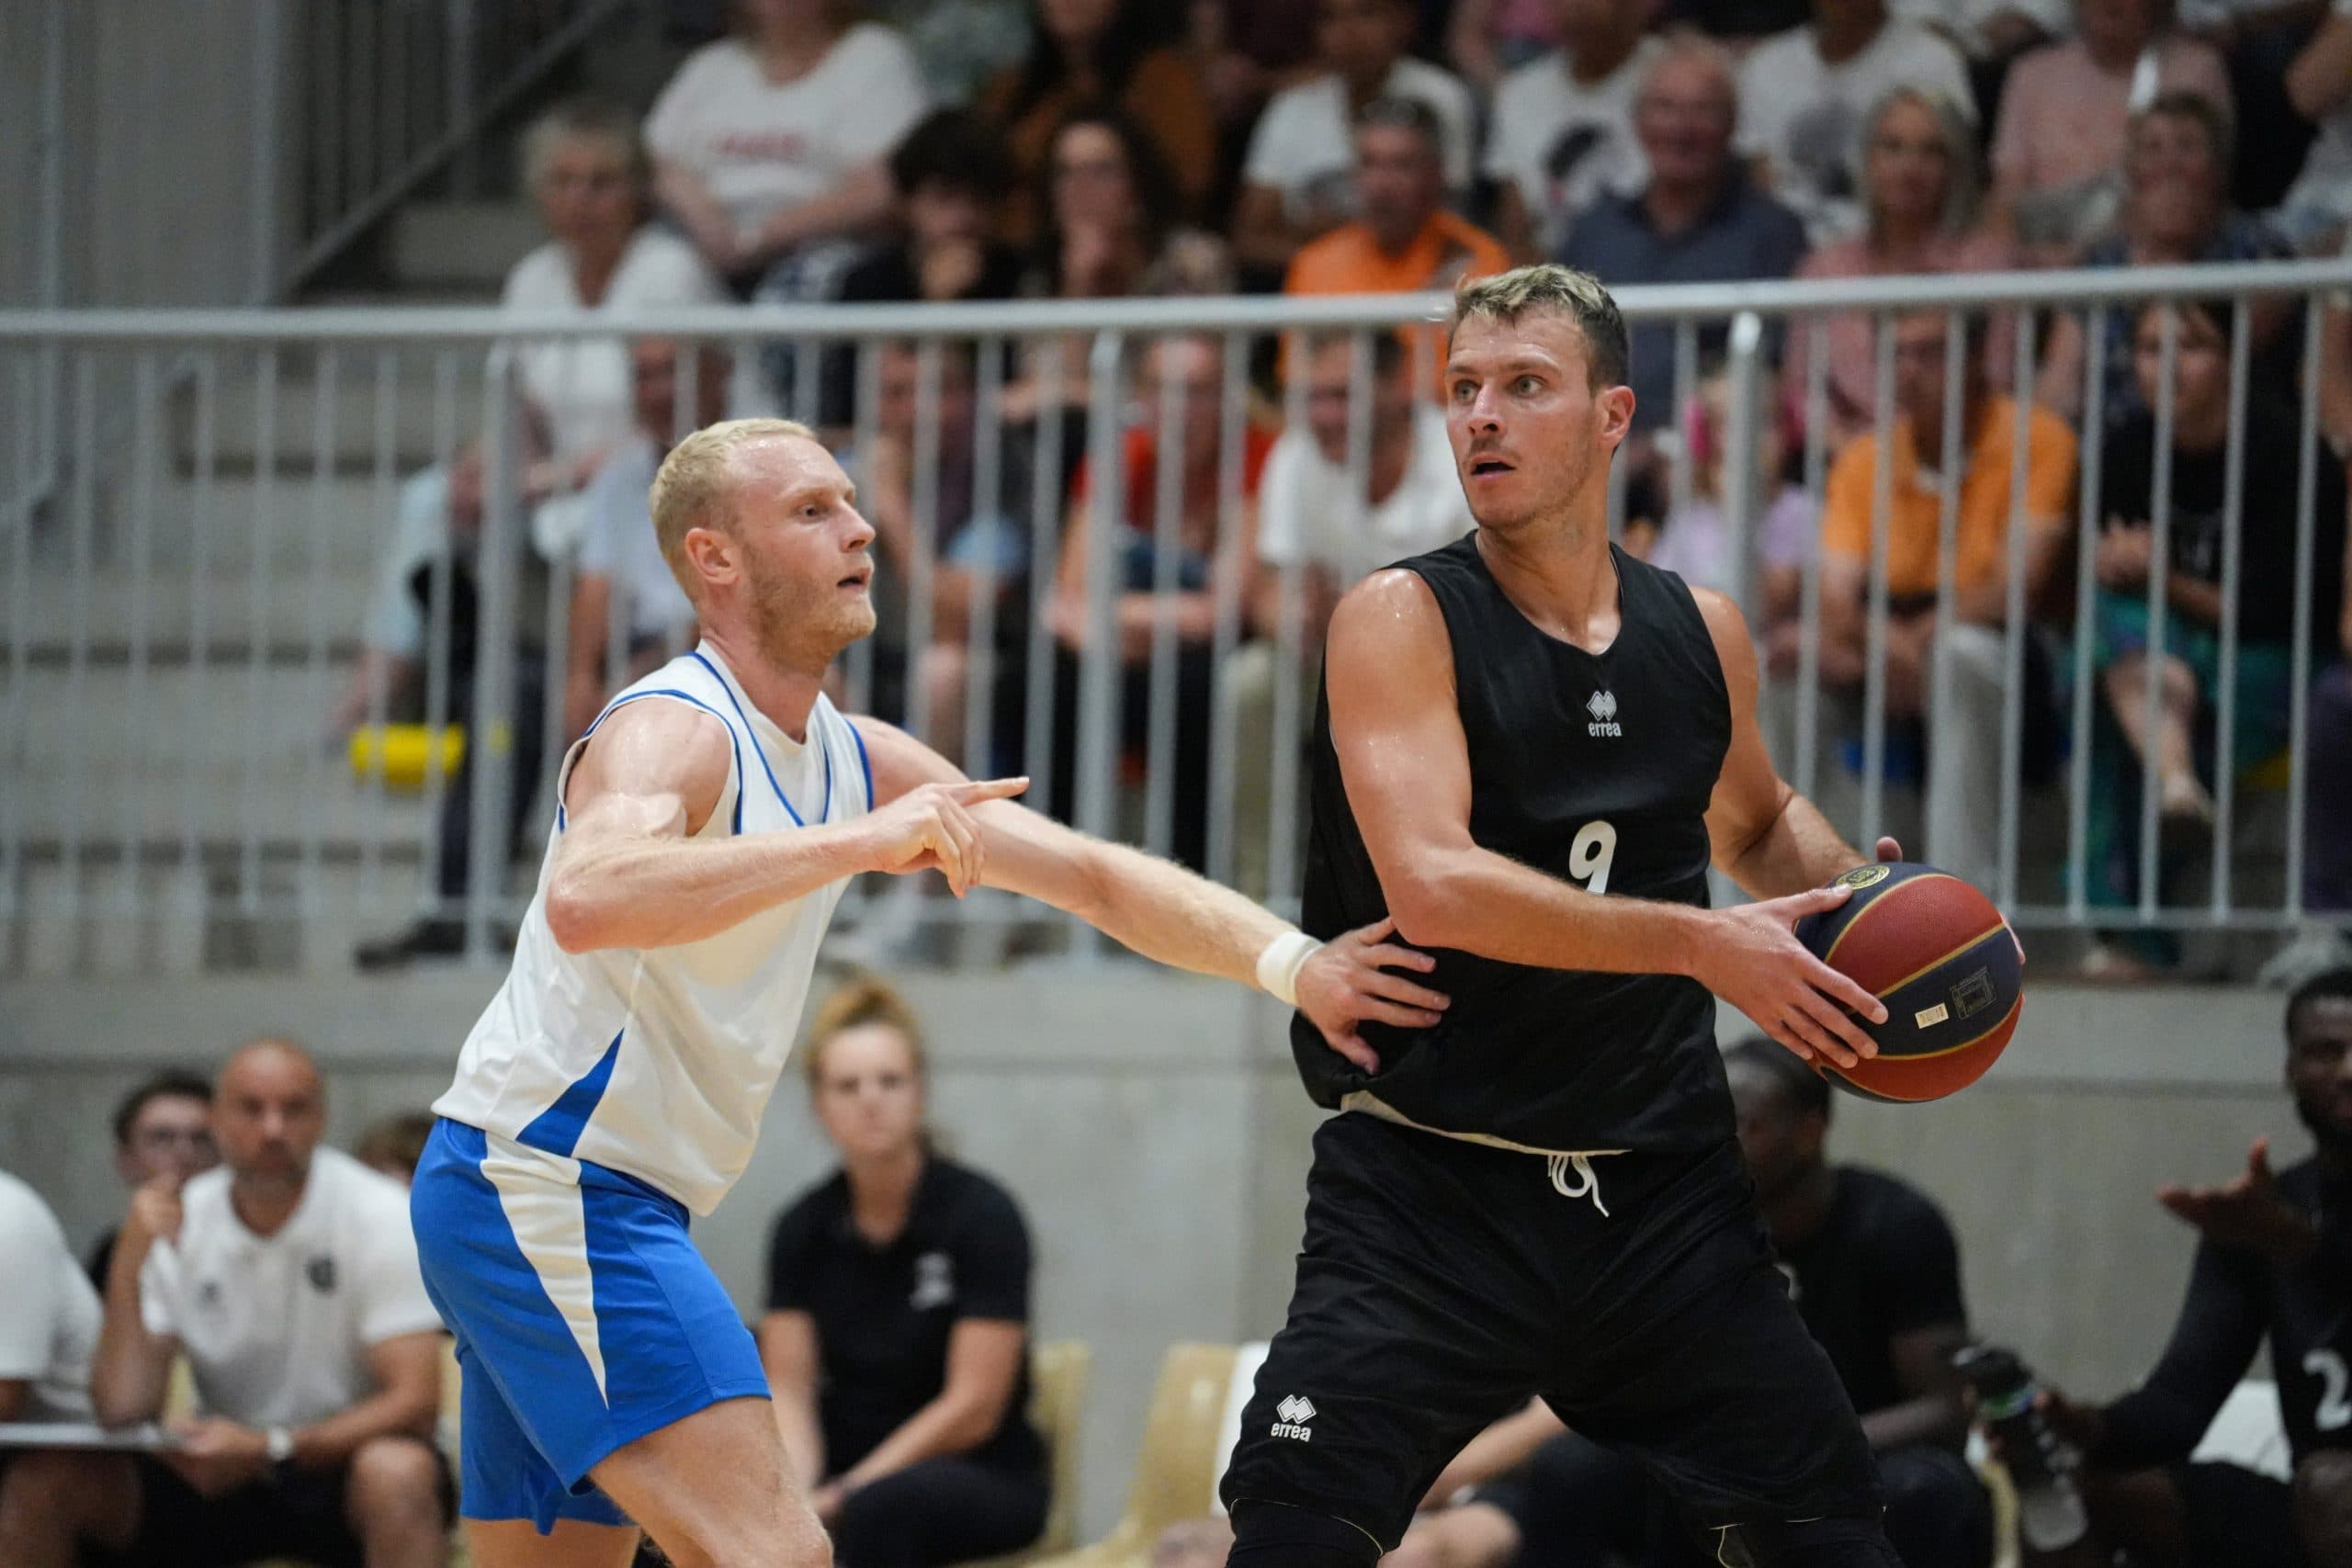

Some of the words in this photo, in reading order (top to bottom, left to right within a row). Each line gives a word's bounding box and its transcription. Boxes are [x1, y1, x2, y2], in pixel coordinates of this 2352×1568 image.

[1588, 722, 1623, 737] errea
[1568, 820, 1617, 895] 9
[2302, 1349, 2352, 1430] 2
[1270, 1422, 1312, 1443] errea
